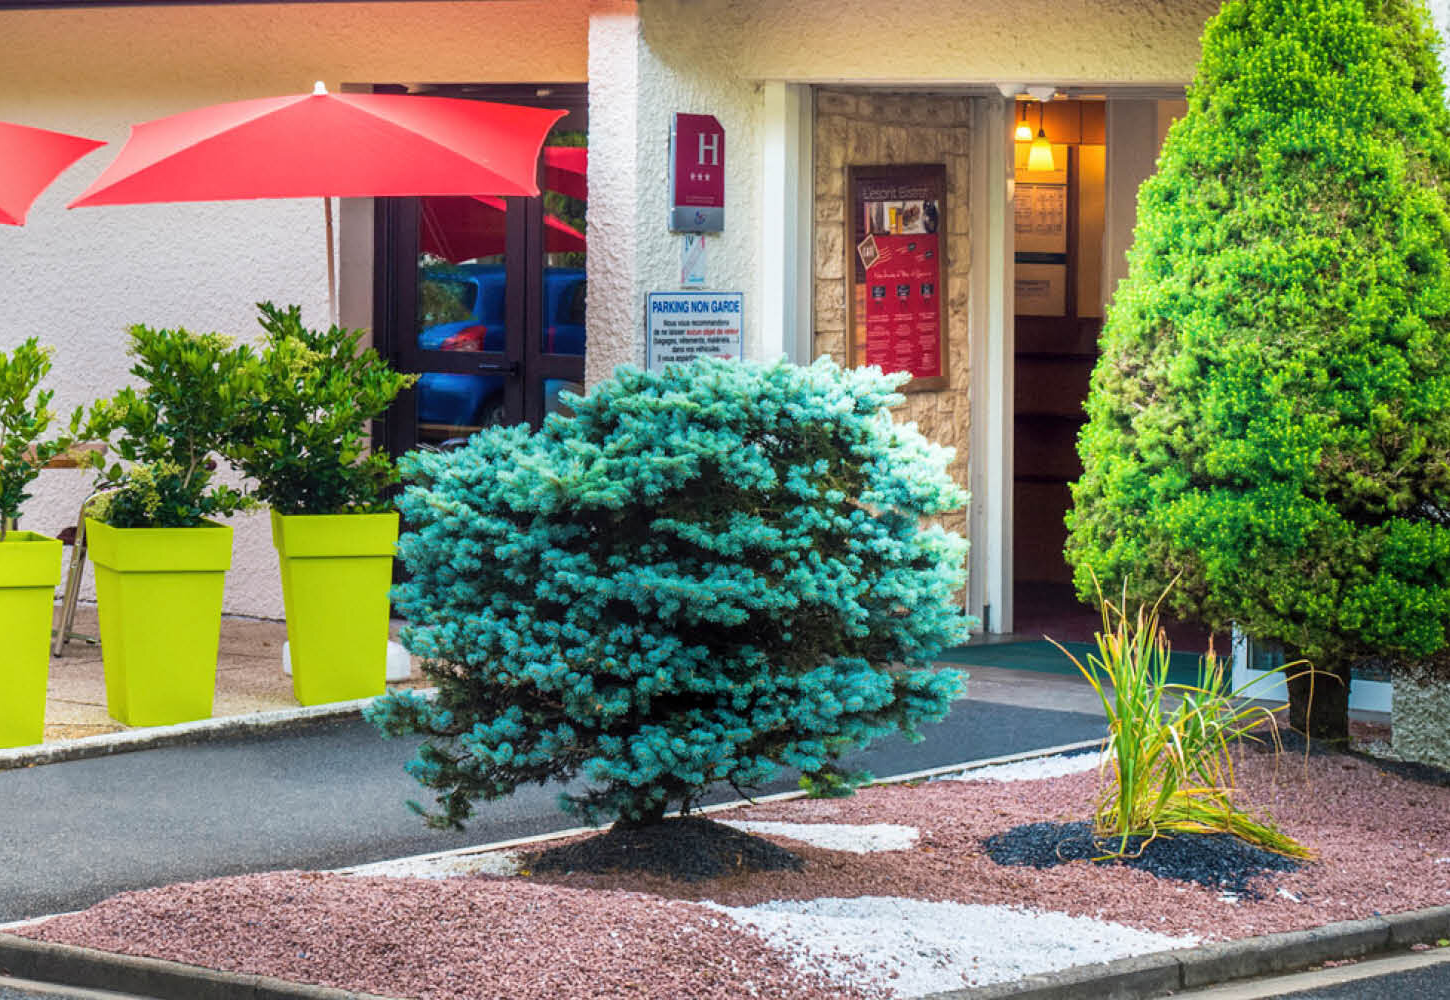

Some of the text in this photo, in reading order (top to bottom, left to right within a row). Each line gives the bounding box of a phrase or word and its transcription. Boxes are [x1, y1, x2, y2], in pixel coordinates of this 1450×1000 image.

[698, 133, 719, 166] H
[652, 300, 690, 313] PARKING
[691, 300, 709, 313] NON
